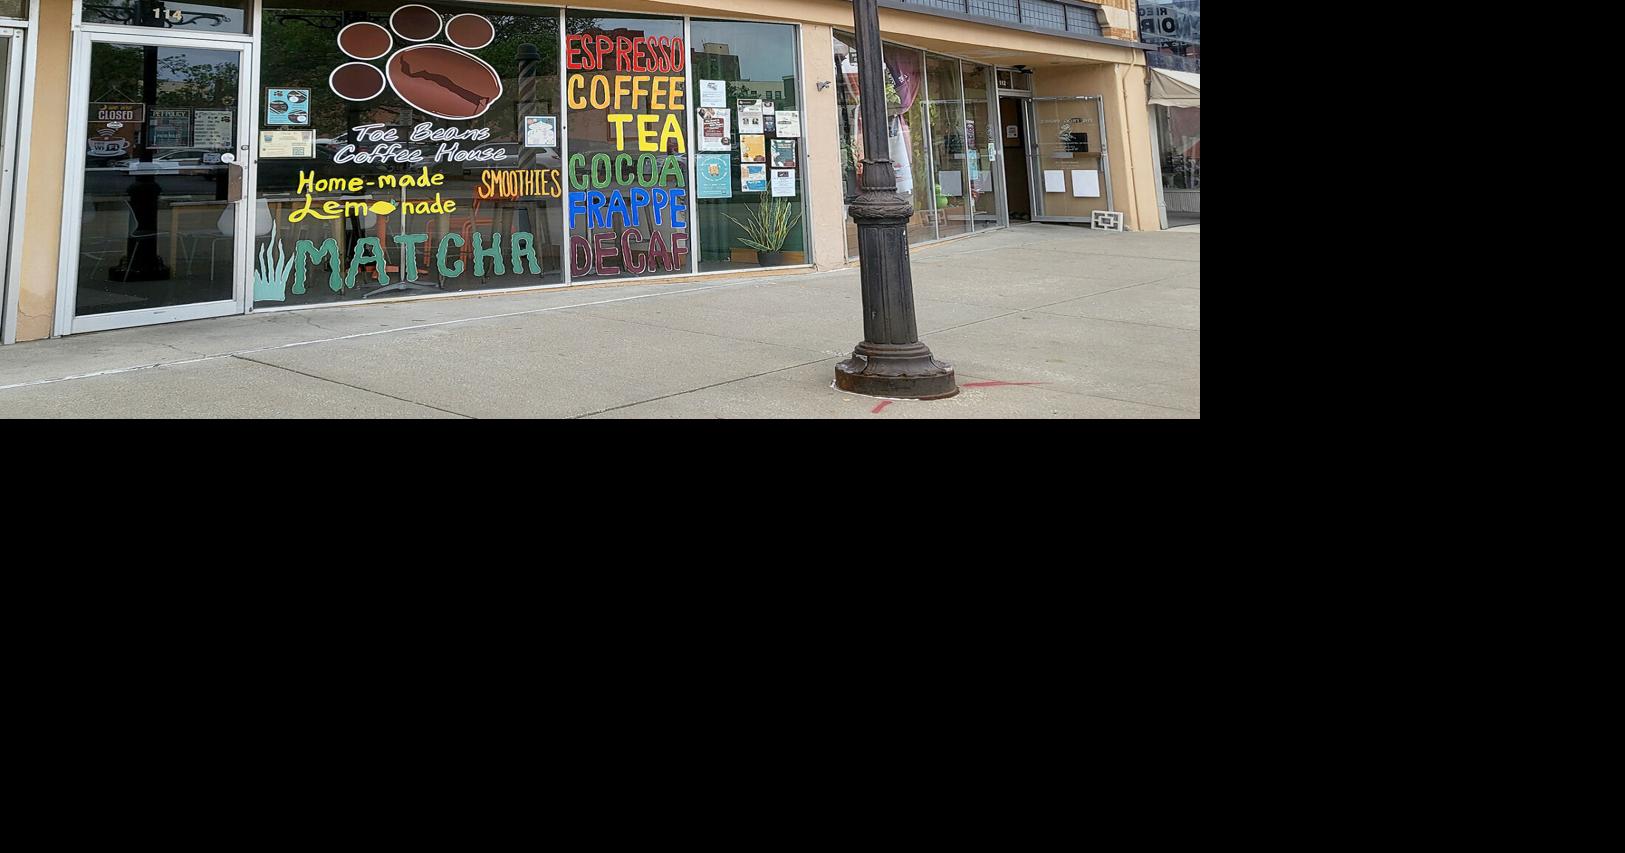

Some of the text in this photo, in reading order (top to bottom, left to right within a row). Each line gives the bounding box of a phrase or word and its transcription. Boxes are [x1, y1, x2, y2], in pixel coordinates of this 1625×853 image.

[152, 7, 182, 21] 114
[566, 34, 685, 73] ESPRESSO
[567, 73, 685, 110] COFFEE
[98, 110, 133, 120] CLOSED
[352, 121, 491, 142] Toe Beans
[607, 114, 685, 153] TEA
[333, 143, 422, 164] Coffee
[434, 142, 508, 162] House
[568, 152, 685, 190] COCOA
[296, 166, 445, 194] Home-made
[477, 169, 562, 199] SMOOTHIES
[568, 187, 686, 229] FRAPPE
[291, 232, 542, 295] MATCHA
[570, 229, 689, 277] DECAF
